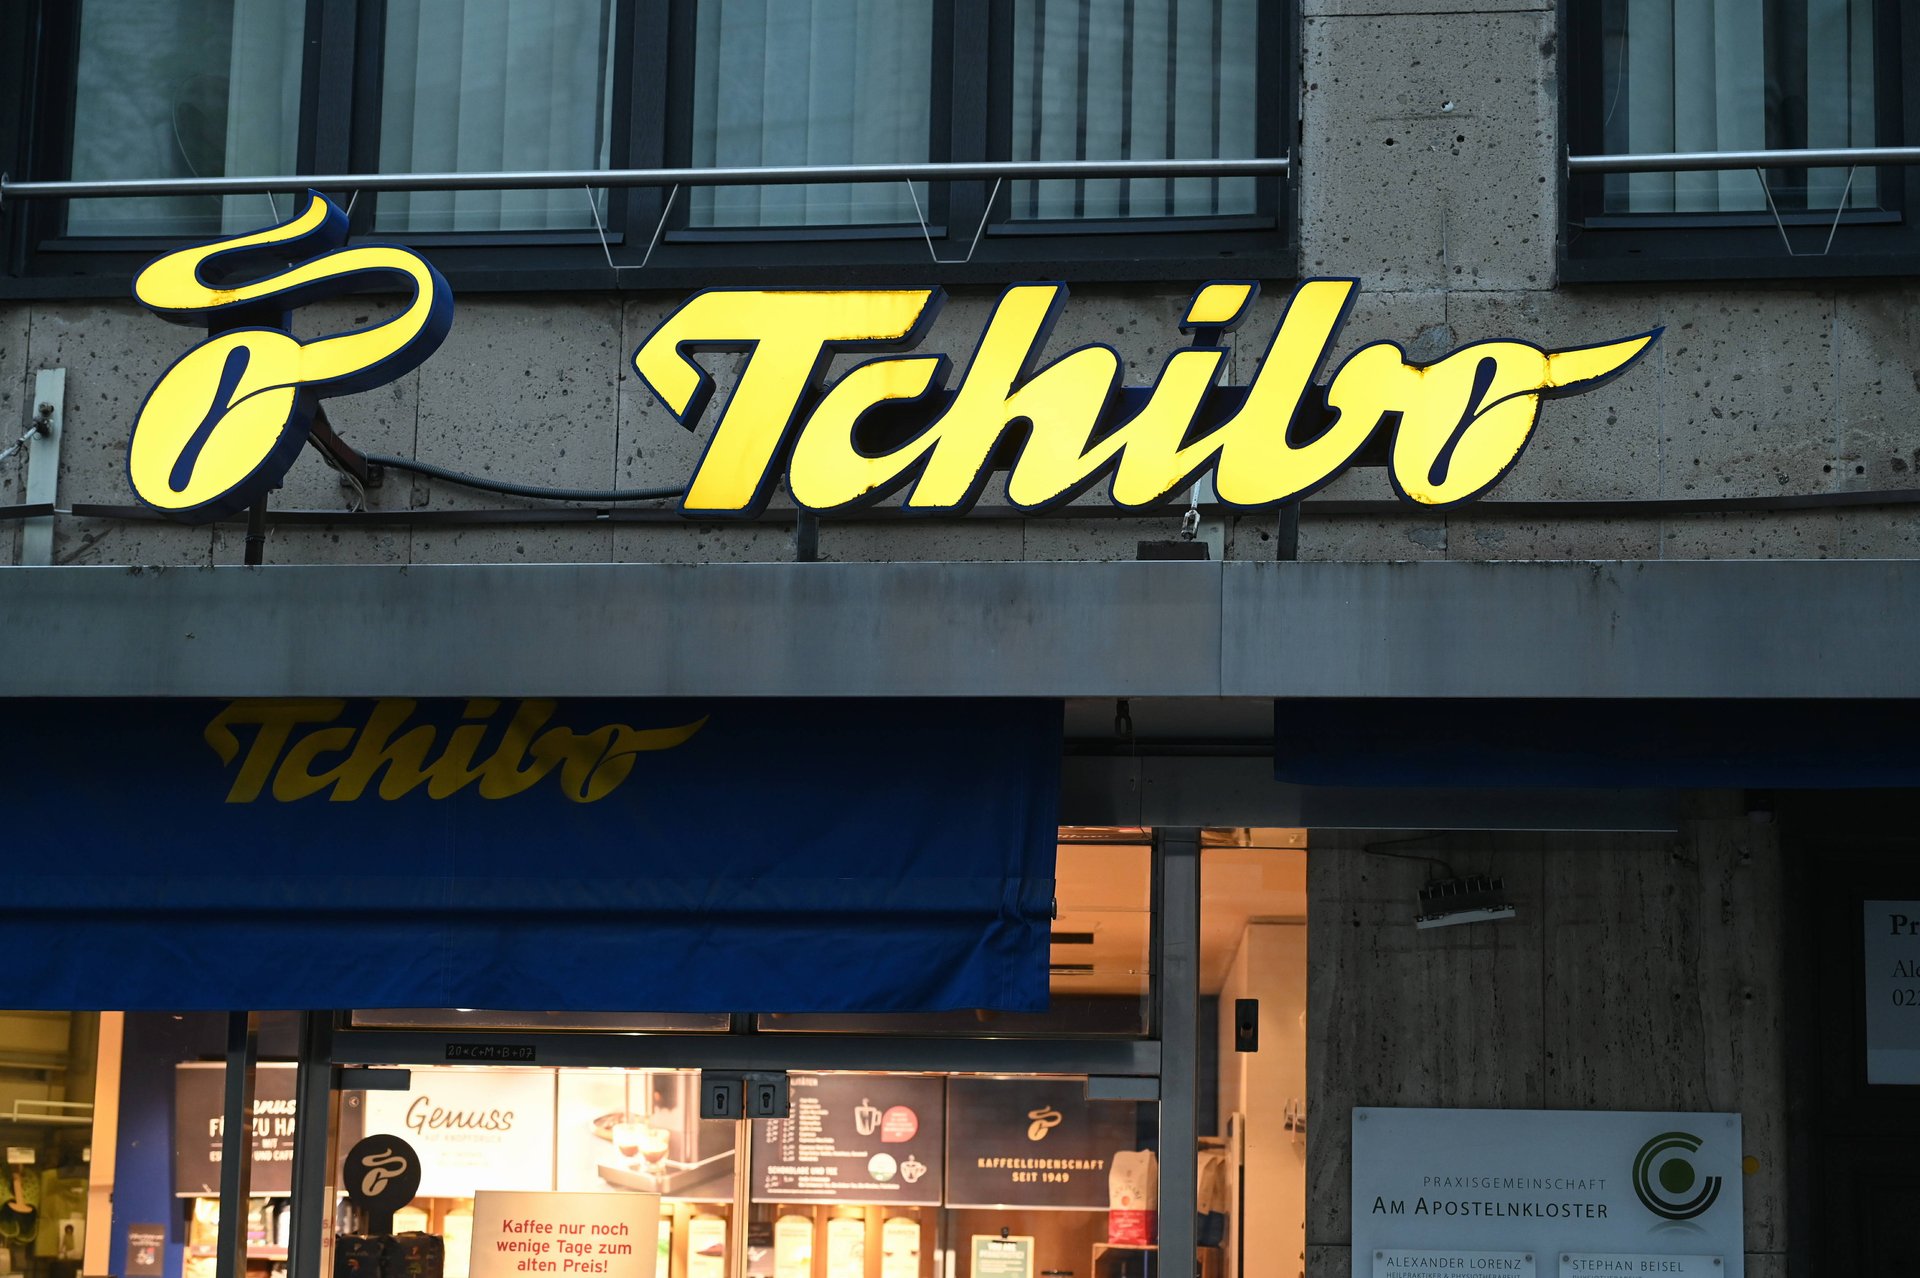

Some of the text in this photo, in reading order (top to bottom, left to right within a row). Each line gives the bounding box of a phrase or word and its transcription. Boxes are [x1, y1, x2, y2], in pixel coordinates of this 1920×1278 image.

[631, 278, 1662, 516] Tchibo
[204, 698, 710, 803] Tchibo
[406, 1096, 514, 1135] Genuss
[977, 1157, 1104, 1171] KAFFEELEIDENSCHAFT
[1011, 1171, 1070, 1183] SEIT 1949
[1423, 1176, 1607, 1191] PRAXISGEMEINSCHAFT
[502, 1219, 629, 1236] Kaffee nur noch
[496, 1239, 632, 1257] wenige Tage zum
[517, 1258, 608, 1273] alten Preis!
[1386, 1256, 1522, 1270] ALEXANDER LORENZ
[1572, 1259, 1684, 1273] STEPHAN BEISEL
